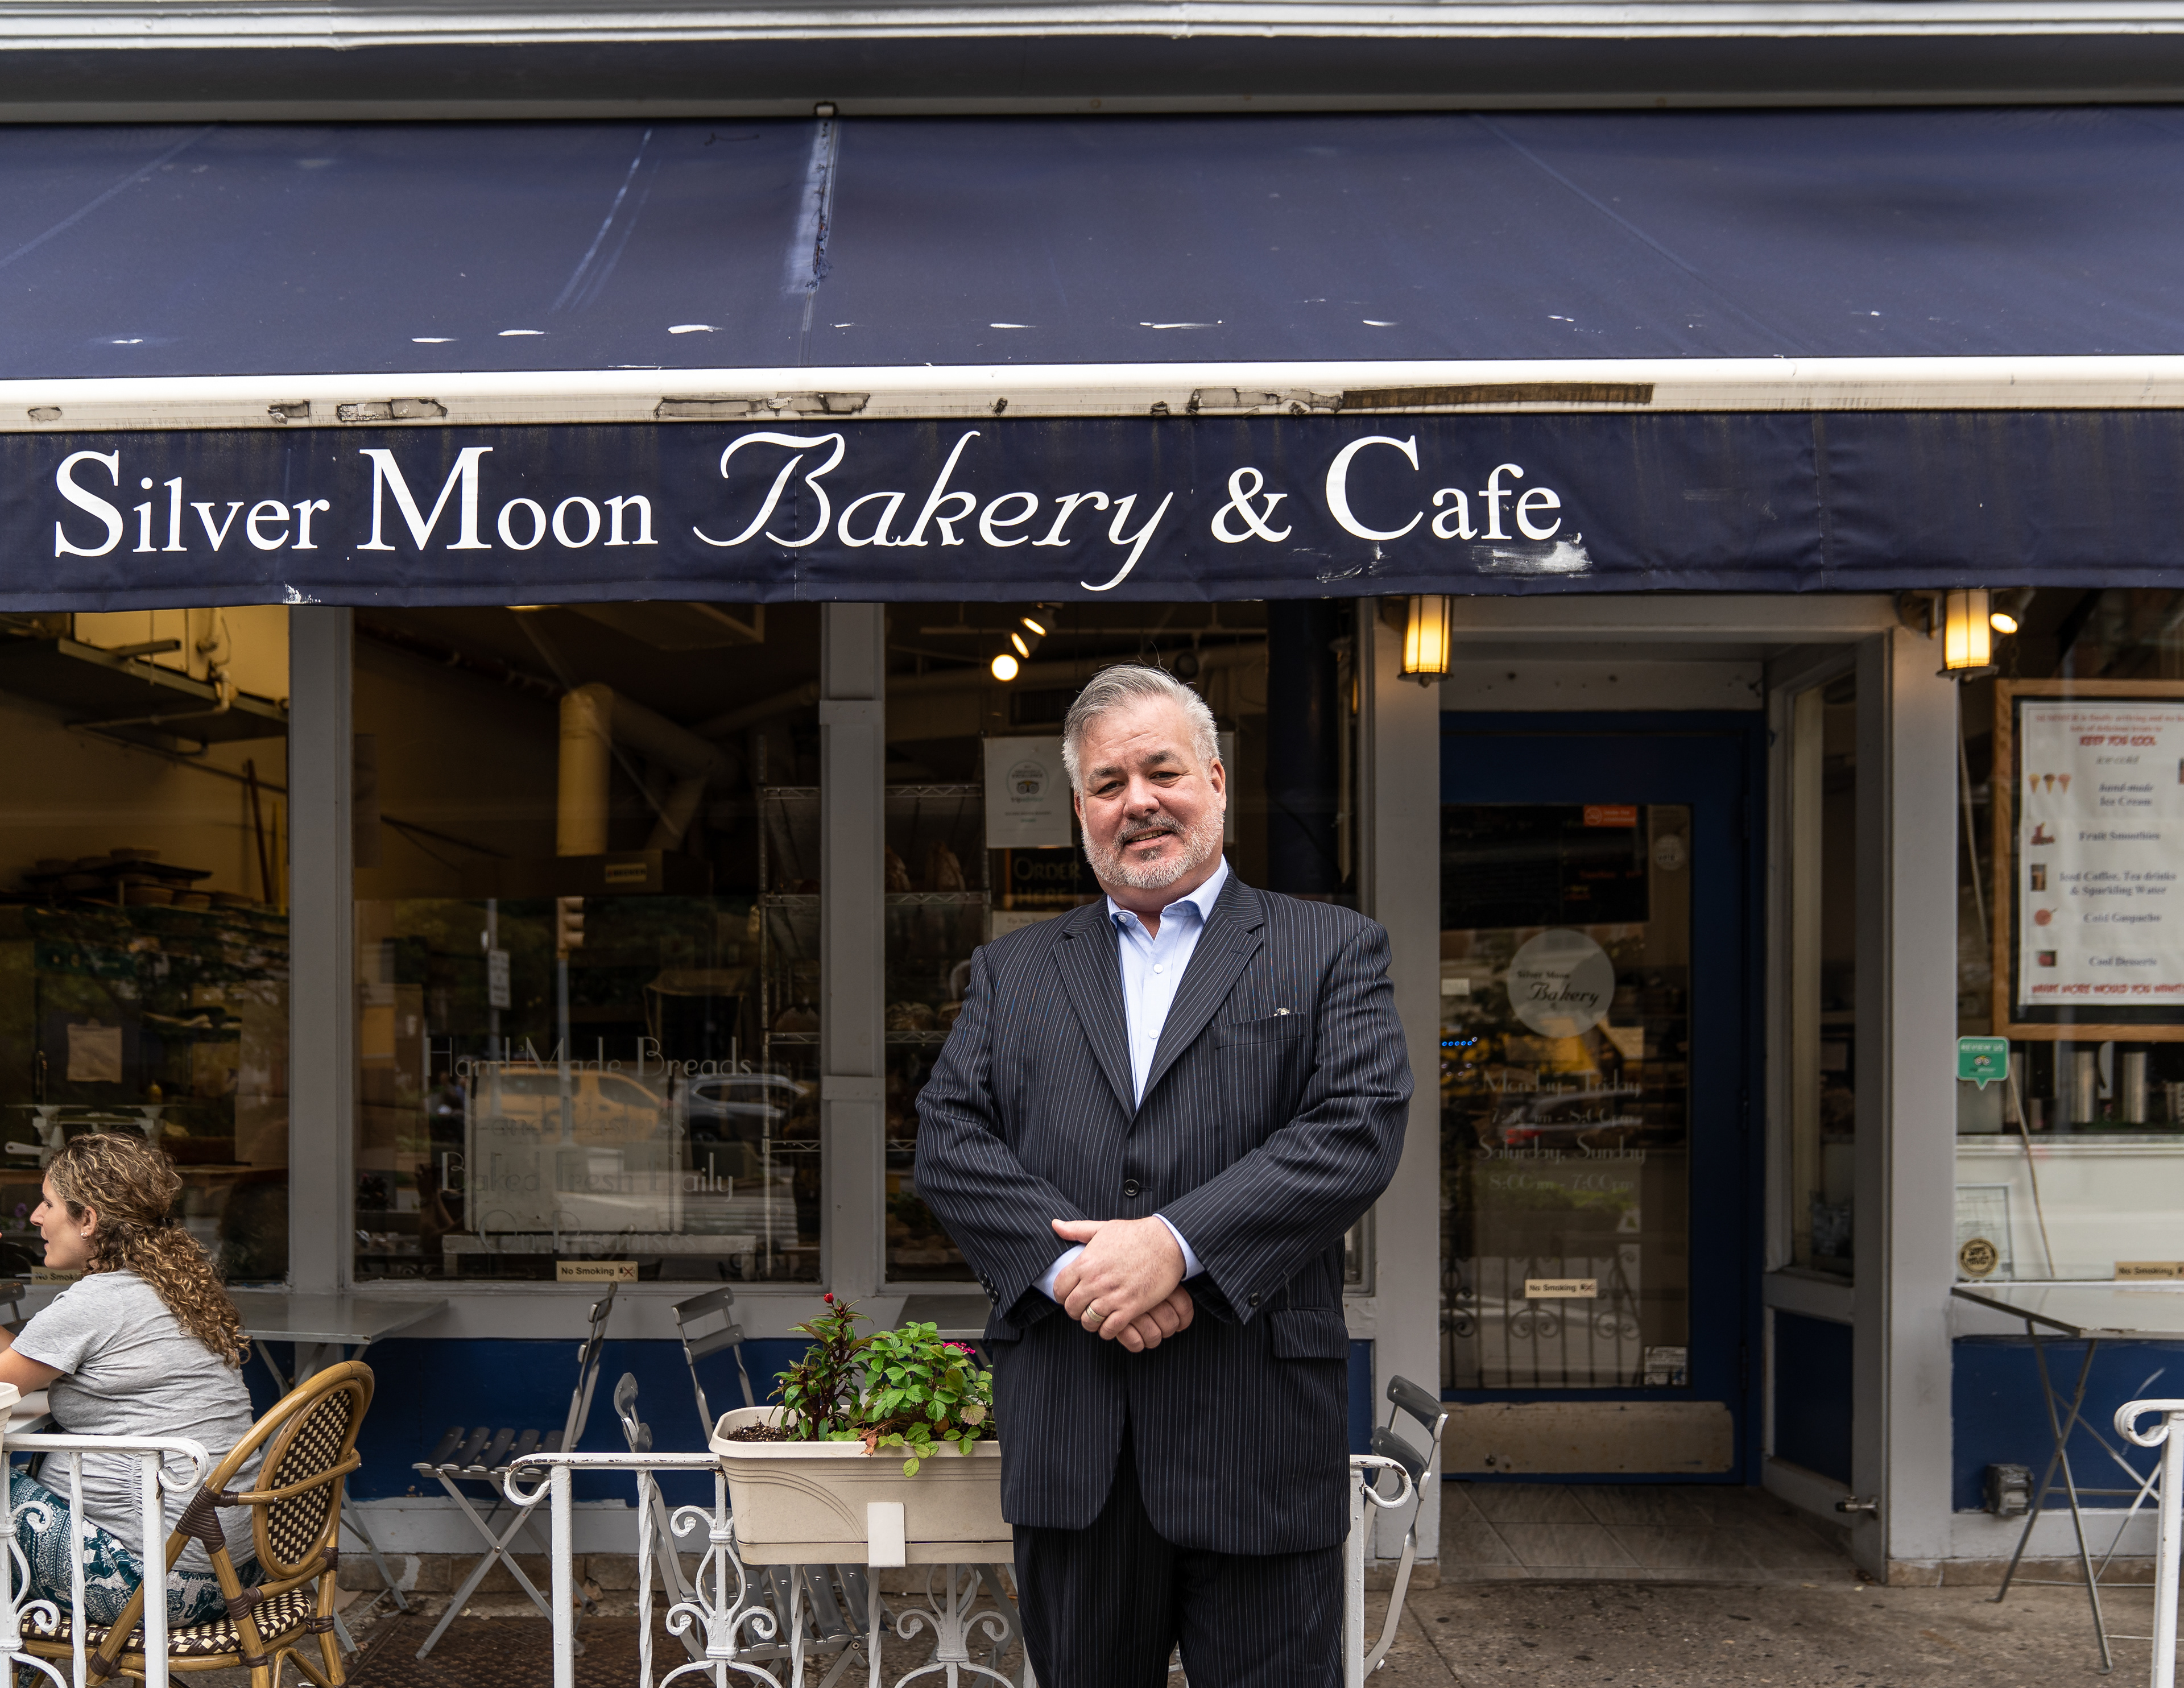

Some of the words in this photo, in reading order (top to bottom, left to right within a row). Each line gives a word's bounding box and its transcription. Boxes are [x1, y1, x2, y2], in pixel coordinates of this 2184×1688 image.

[54, 449, 330, 558] Silver
[357, 446, 659, 551] Moon
[692, 430, 1174, 592] Bakery
[1211, 466, 1292, 544] &
[1326, 435, 1562, 541] Cafe
[1546, 970, 1571, 979] Moon
[1528, 981, 1600, 1008] Bakery
[638, 1036, 752, 1077] Breads
[1574, 1134, 1647, 1165] Sunday
[556, 1151, 634, 1192] Fresh
[561, 1267, 574, 1275] No
[576, 1266, 615, 1277] Smoking
[2133, 1267, 2174, 1277] Smoking
[1542, 1284, 1577, 1293] Smoking
